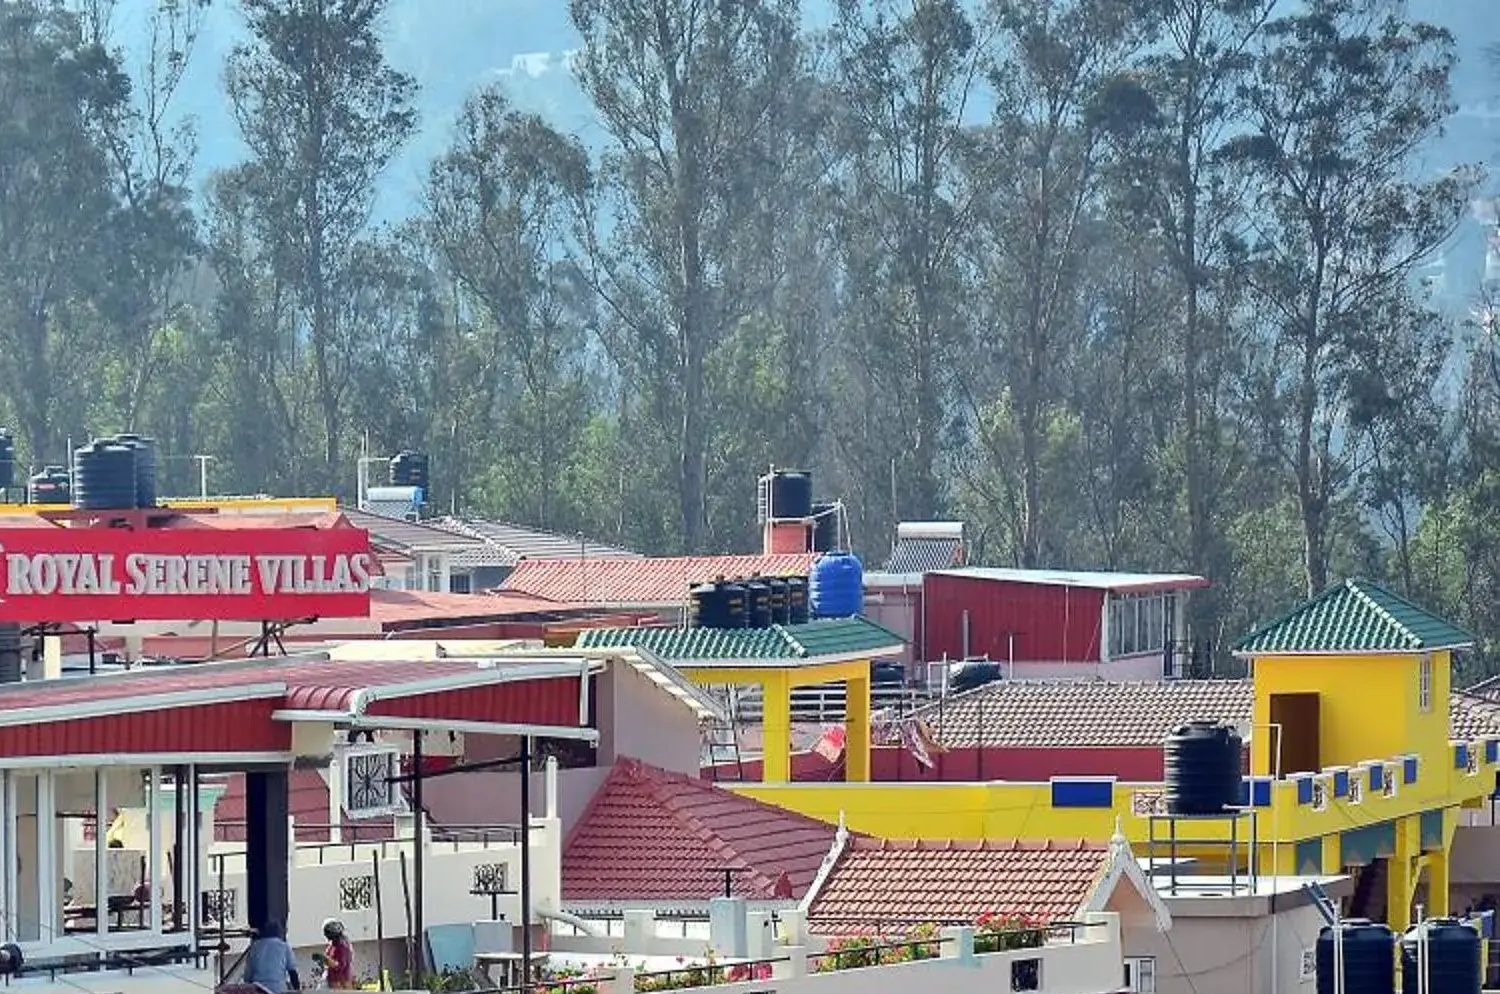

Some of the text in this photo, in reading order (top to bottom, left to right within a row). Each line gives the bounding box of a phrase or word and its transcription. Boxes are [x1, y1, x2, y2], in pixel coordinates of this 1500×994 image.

[6, 552, 121, 596] ROYAL
[126, 553, 252, 596] SERENE
[254, 553, 370, 595] VILLAS
